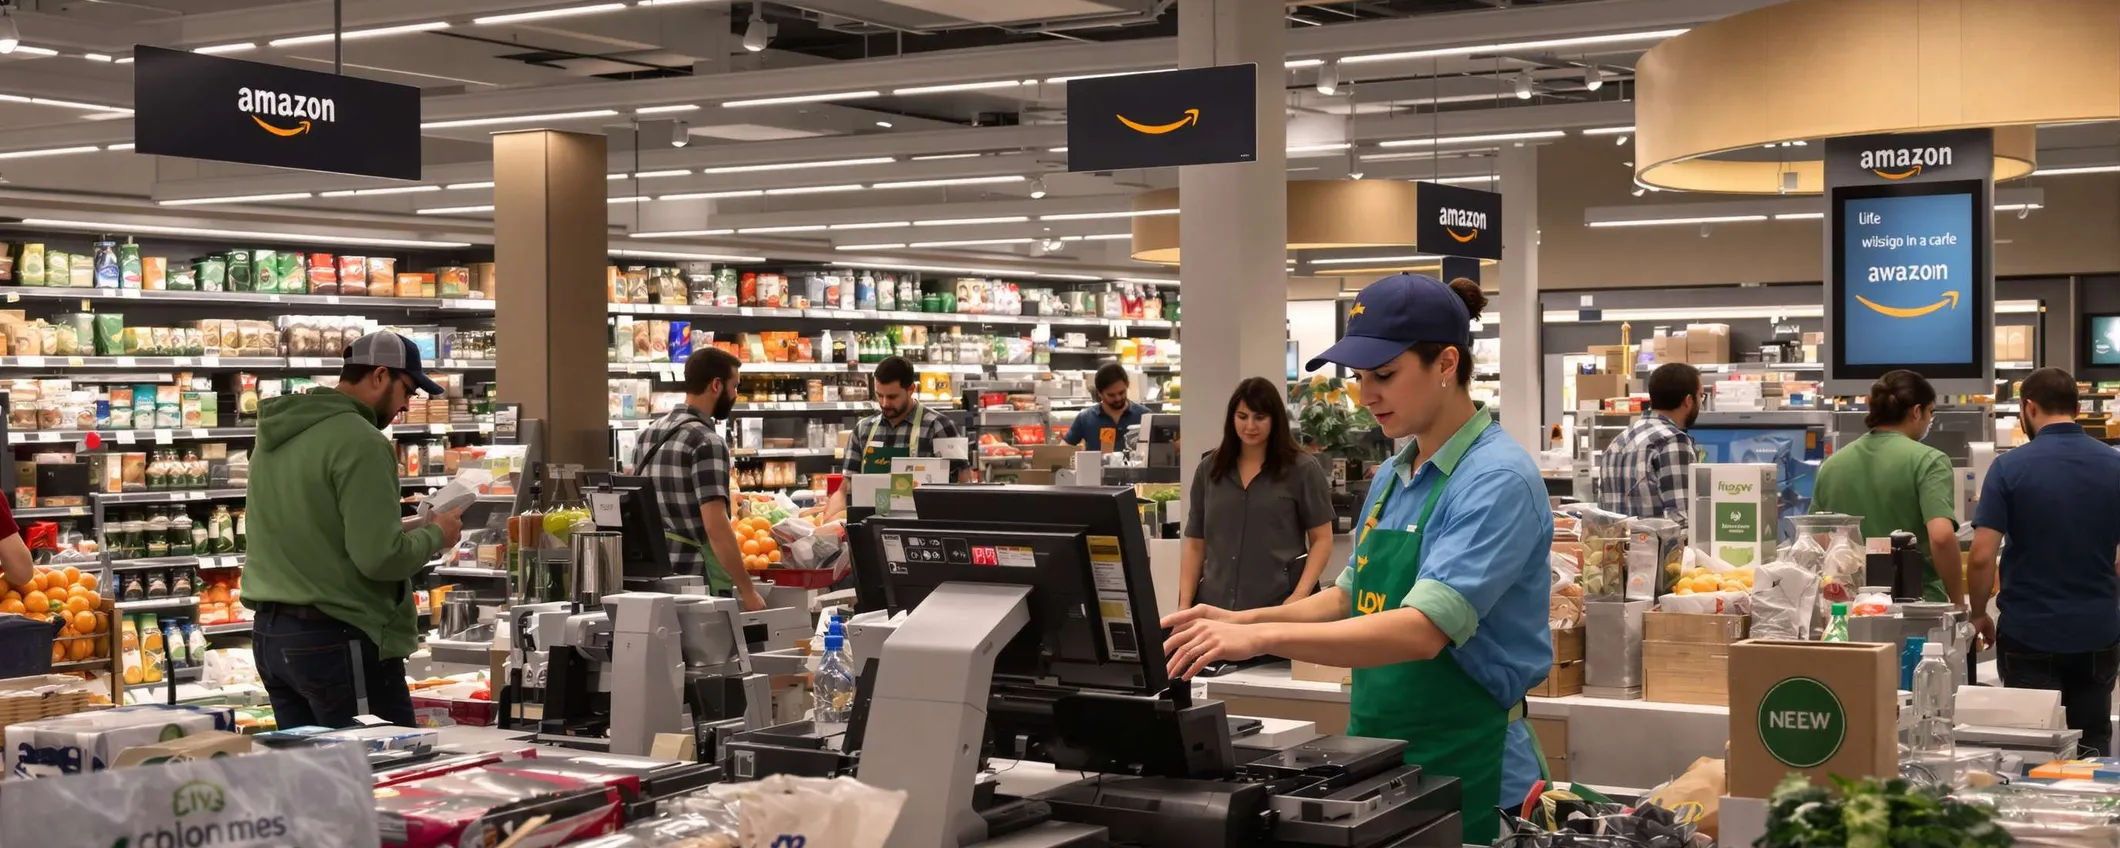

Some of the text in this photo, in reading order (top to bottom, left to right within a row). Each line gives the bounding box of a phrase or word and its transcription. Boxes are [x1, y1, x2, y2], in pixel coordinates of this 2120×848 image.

[238, 86, 335, 122] amazon
[1860, 146, 1952, 169] amazon
[1439, 206, 1487, 230] amazon
[1919, 236, 1927, 247] a
[1769, 710, 1831, 730] NEEW
